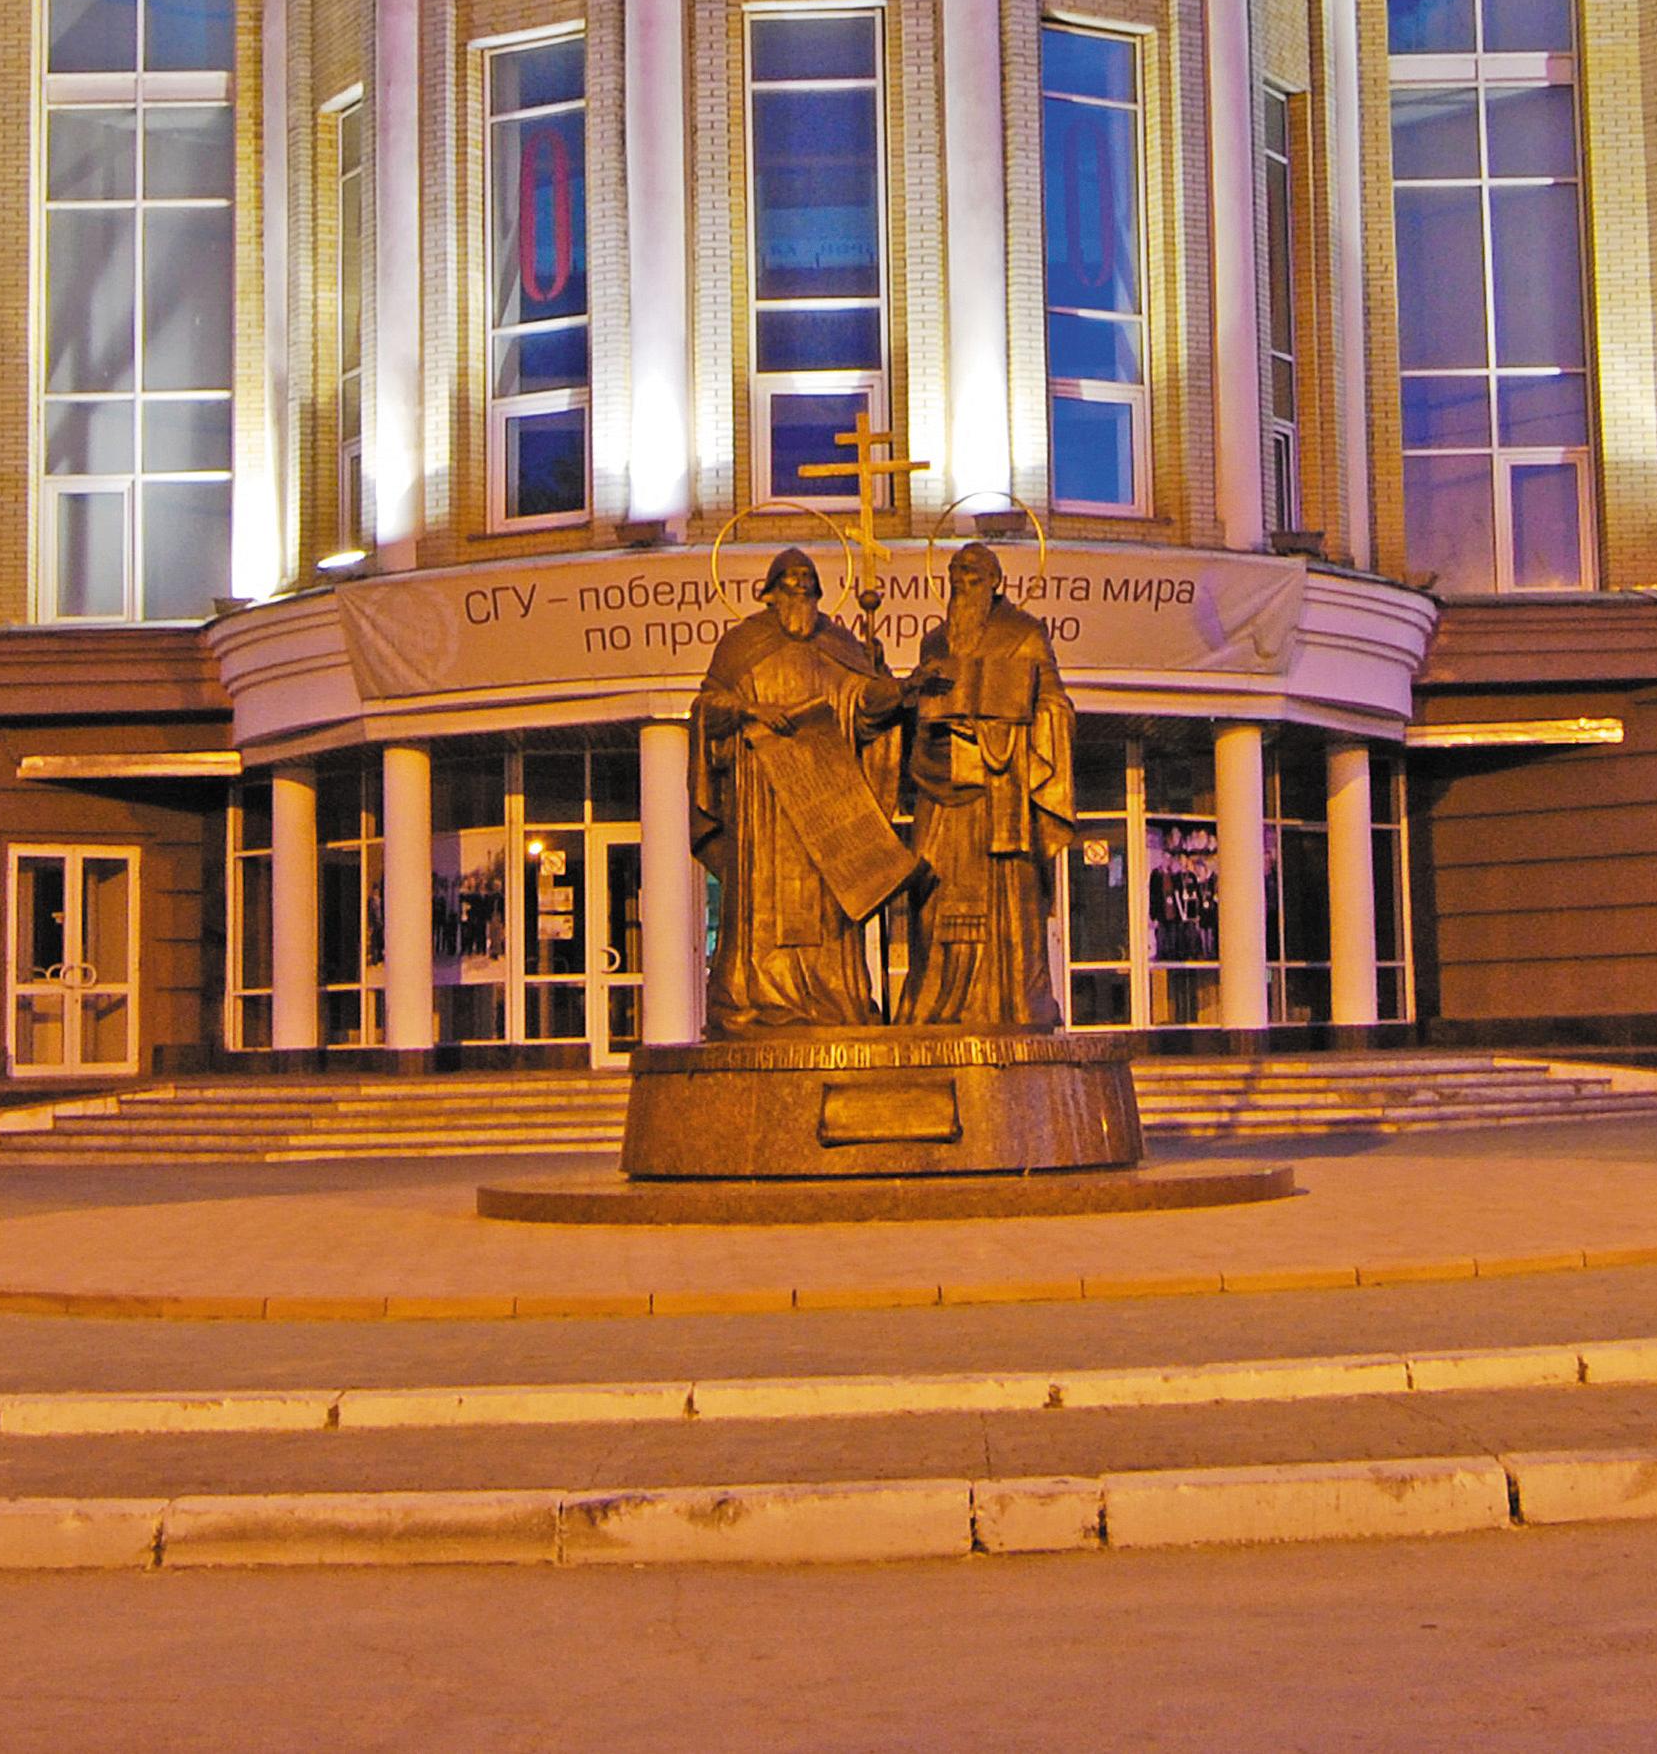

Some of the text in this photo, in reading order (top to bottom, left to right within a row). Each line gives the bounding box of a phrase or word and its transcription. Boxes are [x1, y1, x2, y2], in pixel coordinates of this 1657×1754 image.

[464, 583, 537, 625] СГУ
[578, 574, 769, 613] победите
[1101, 575, 1197, 611] мира
[583, 624, 633, 653] по
